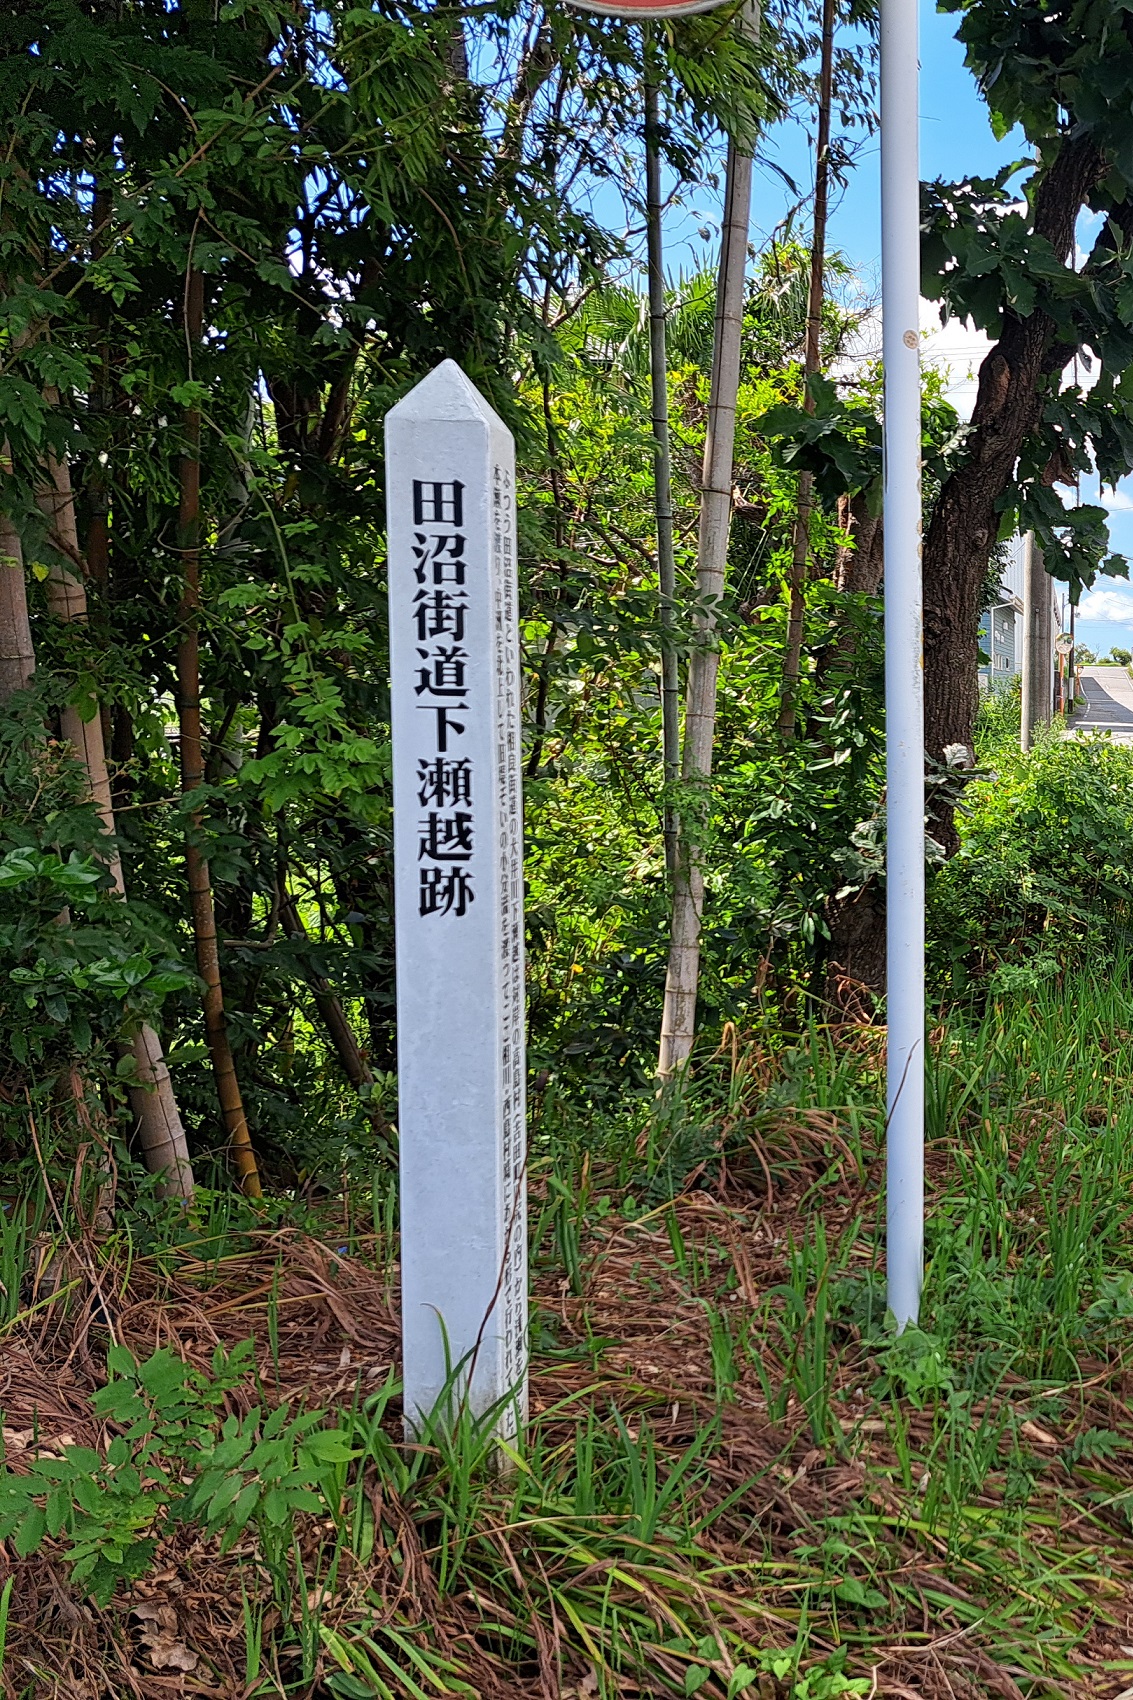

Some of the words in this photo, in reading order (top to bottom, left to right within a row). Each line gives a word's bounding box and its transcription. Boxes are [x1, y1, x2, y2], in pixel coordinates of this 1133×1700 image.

[411, 479, 475, 917] 田沼街道下瀬越跡
